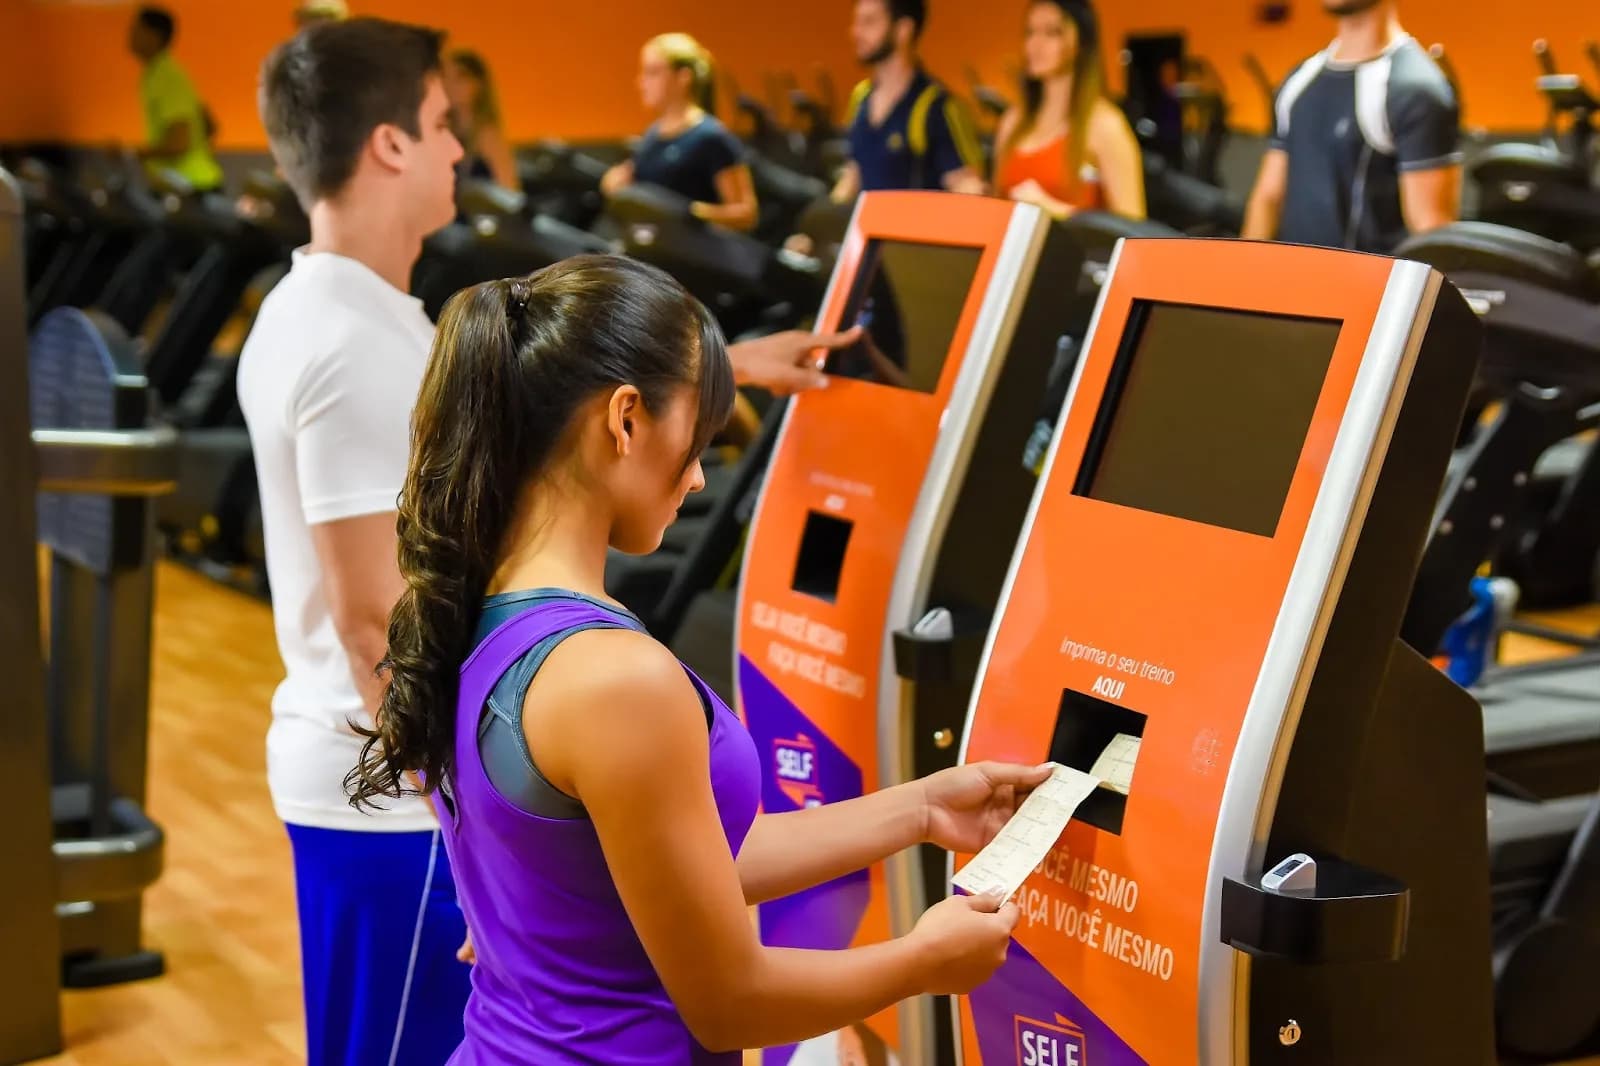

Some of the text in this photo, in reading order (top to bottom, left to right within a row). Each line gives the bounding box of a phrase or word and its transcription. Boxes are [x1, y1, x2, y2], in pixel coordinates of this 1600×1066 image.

[1060, 637, 1175, 685] Imprima o seu treino
[1092, 676, 1125, 699] AQUI
[777, 748, 814, 779] SELF
[1070, 860, 1139, 912] MESMO
[1010, 884, 1174, 980] AÇA VOCÊ MESMO
